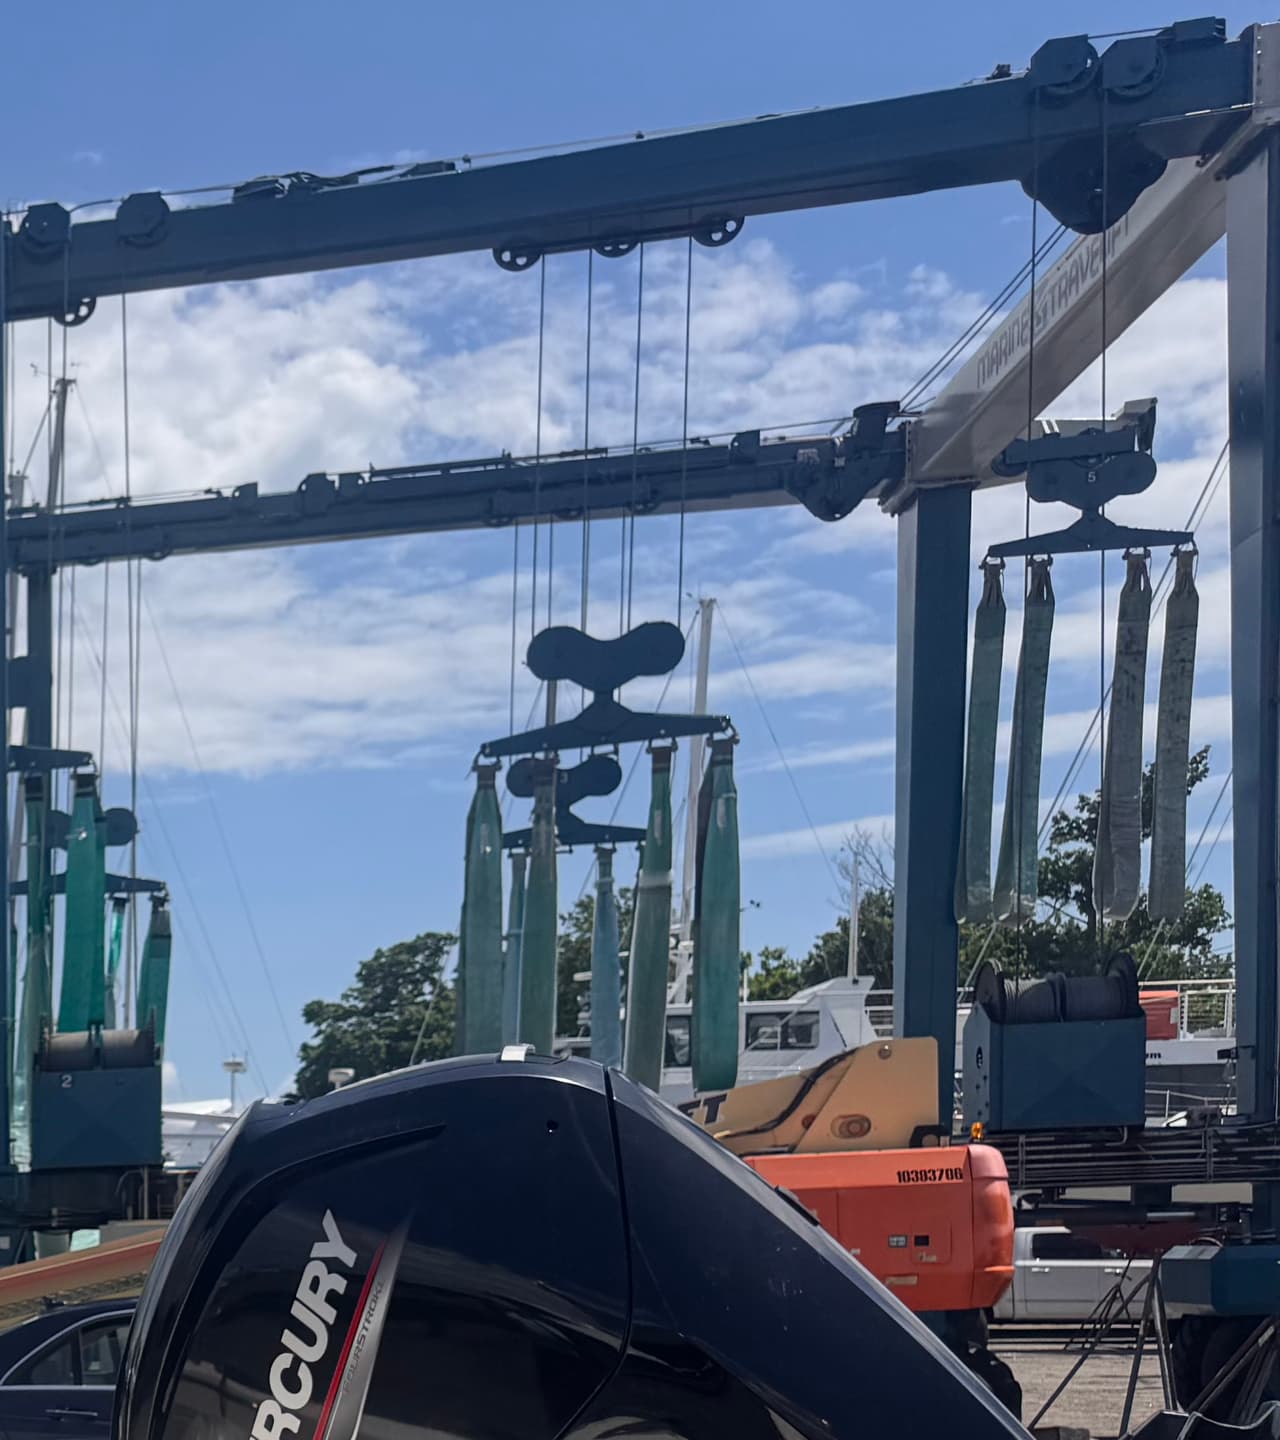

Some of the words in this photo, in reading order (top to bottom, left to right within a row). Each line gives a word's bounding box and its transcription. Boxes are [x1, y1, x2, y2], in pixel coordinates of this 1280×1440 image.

[977, 308, 1030, 389] MARINE
[1048, 214, 1129, 317] TRAVEIF
[1087, 471, 1097, 483] 5
[61, 1074, 73, 1088] 2
